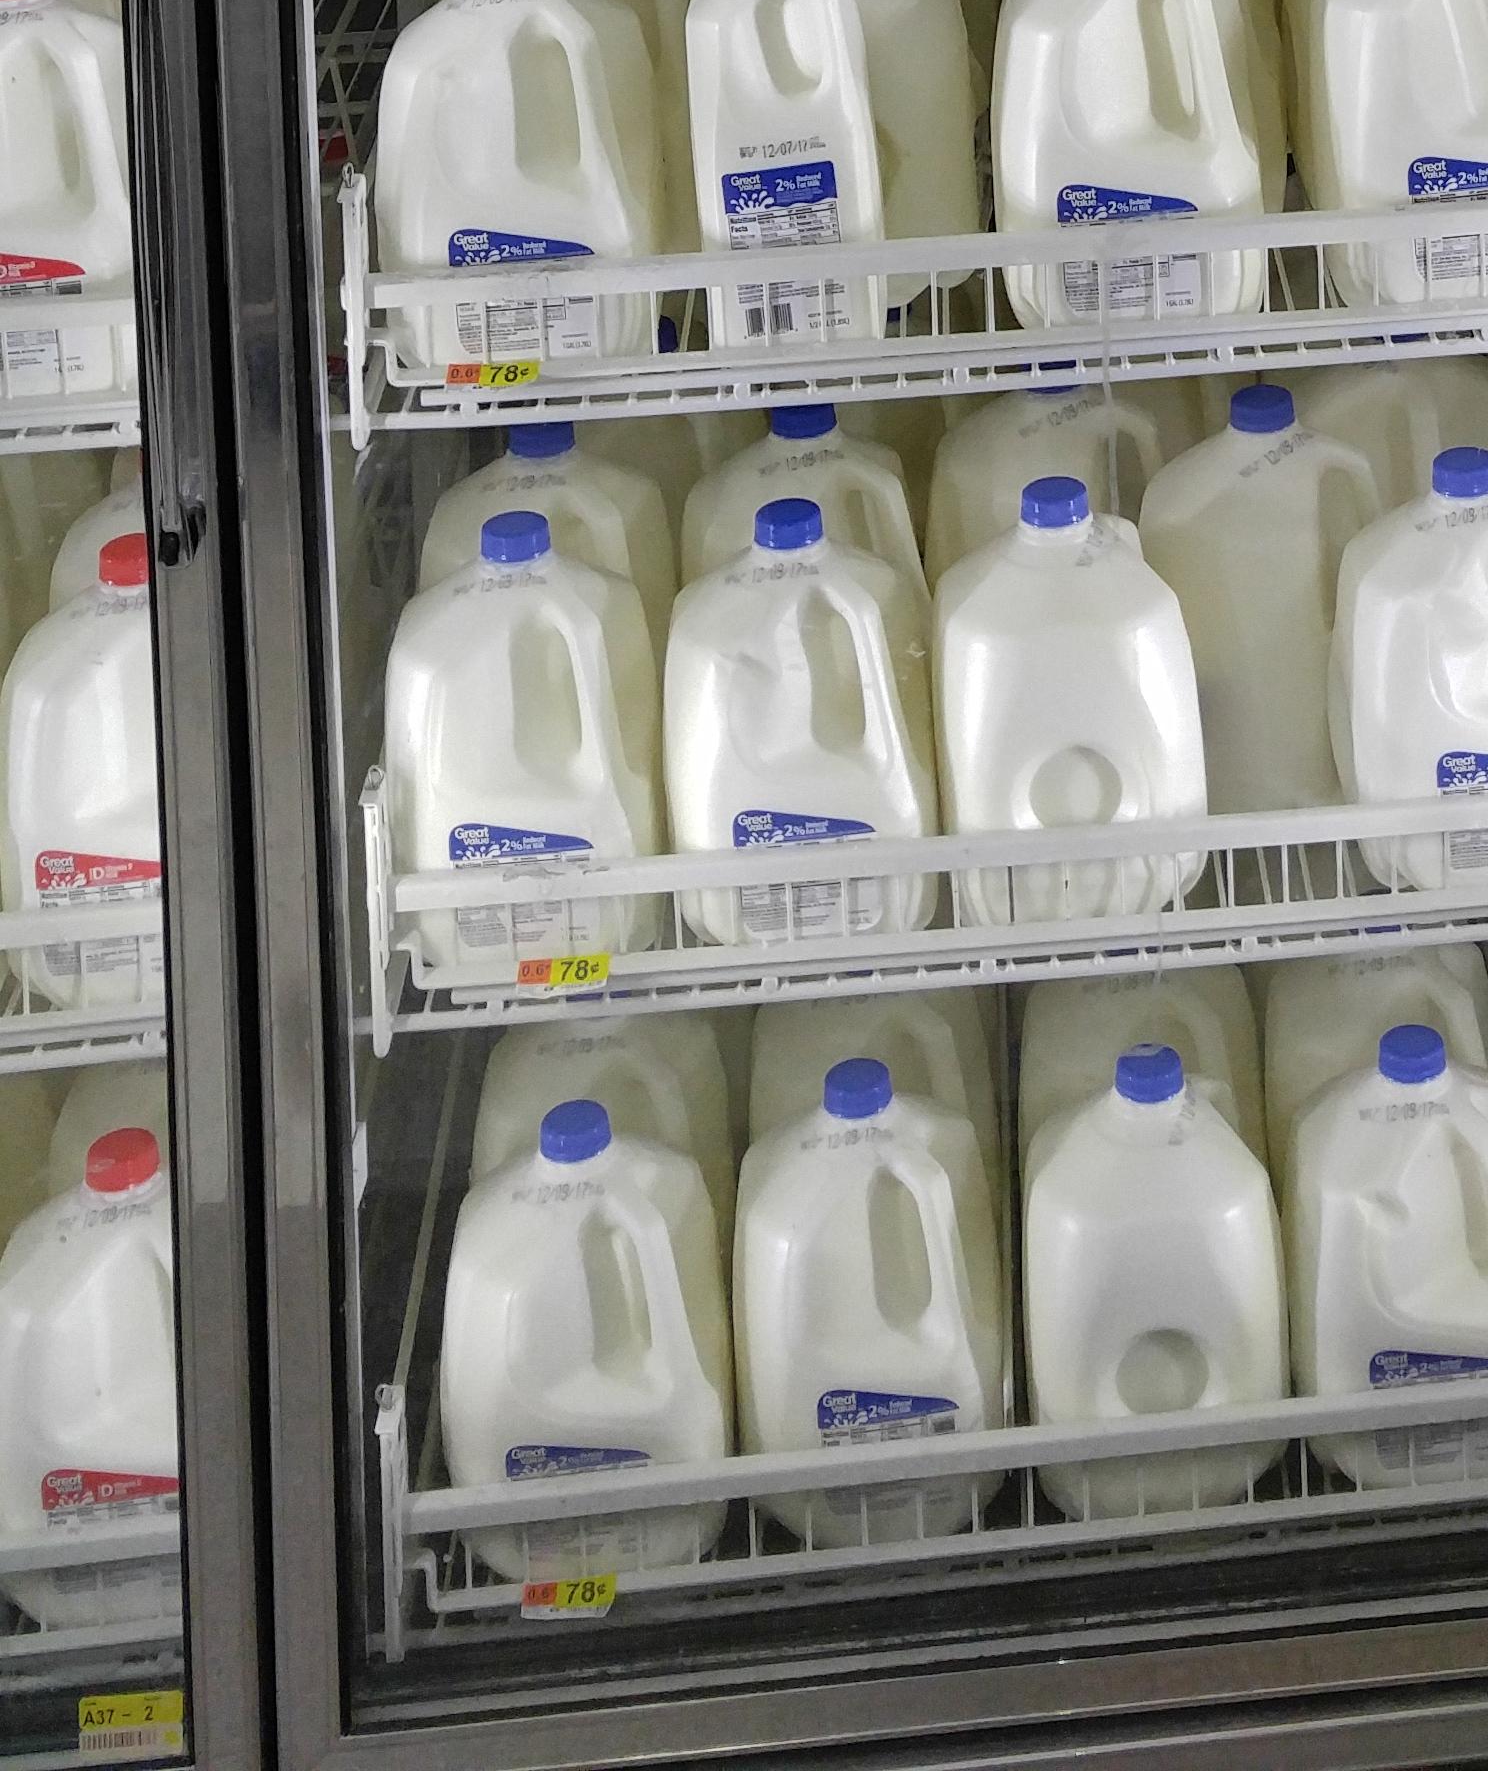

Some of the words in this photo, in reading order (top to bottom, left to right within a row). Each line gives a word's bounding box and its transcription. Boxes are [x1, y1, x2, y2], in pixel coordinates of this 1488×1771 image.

[1413, 161, 1446, 173] Great
[1421, 170, 1446, 179] Value
[1458, 172, 1478, 185] 2%
[730, 175, 760, 187] Great
[739, 182, 760, 191] Value
[776, 179, 796, 192] 2%
[1062, 189, 1096, 200] Great
[1070, 197, 1096, 207] Value
[1107, 201, 1129, 214] 2%
[453, 234, 488, 245] Great
[461, 242, 488, 251] Value
[500, 245, 522, 257] 2%
[1442, 756, 1475, 767] Great
[738, 814, 772, 826] Great
[455, 829, 489, 840] Great
[784, 825, 806, 837] 2%
[463, 836, 489, 845] Value
[501, 839, 523, 851] 2%
[40, 857, 74, 867] Great
[83, 1709, 115, 1726] A37
[144, 1704, 154, 1721] 2
